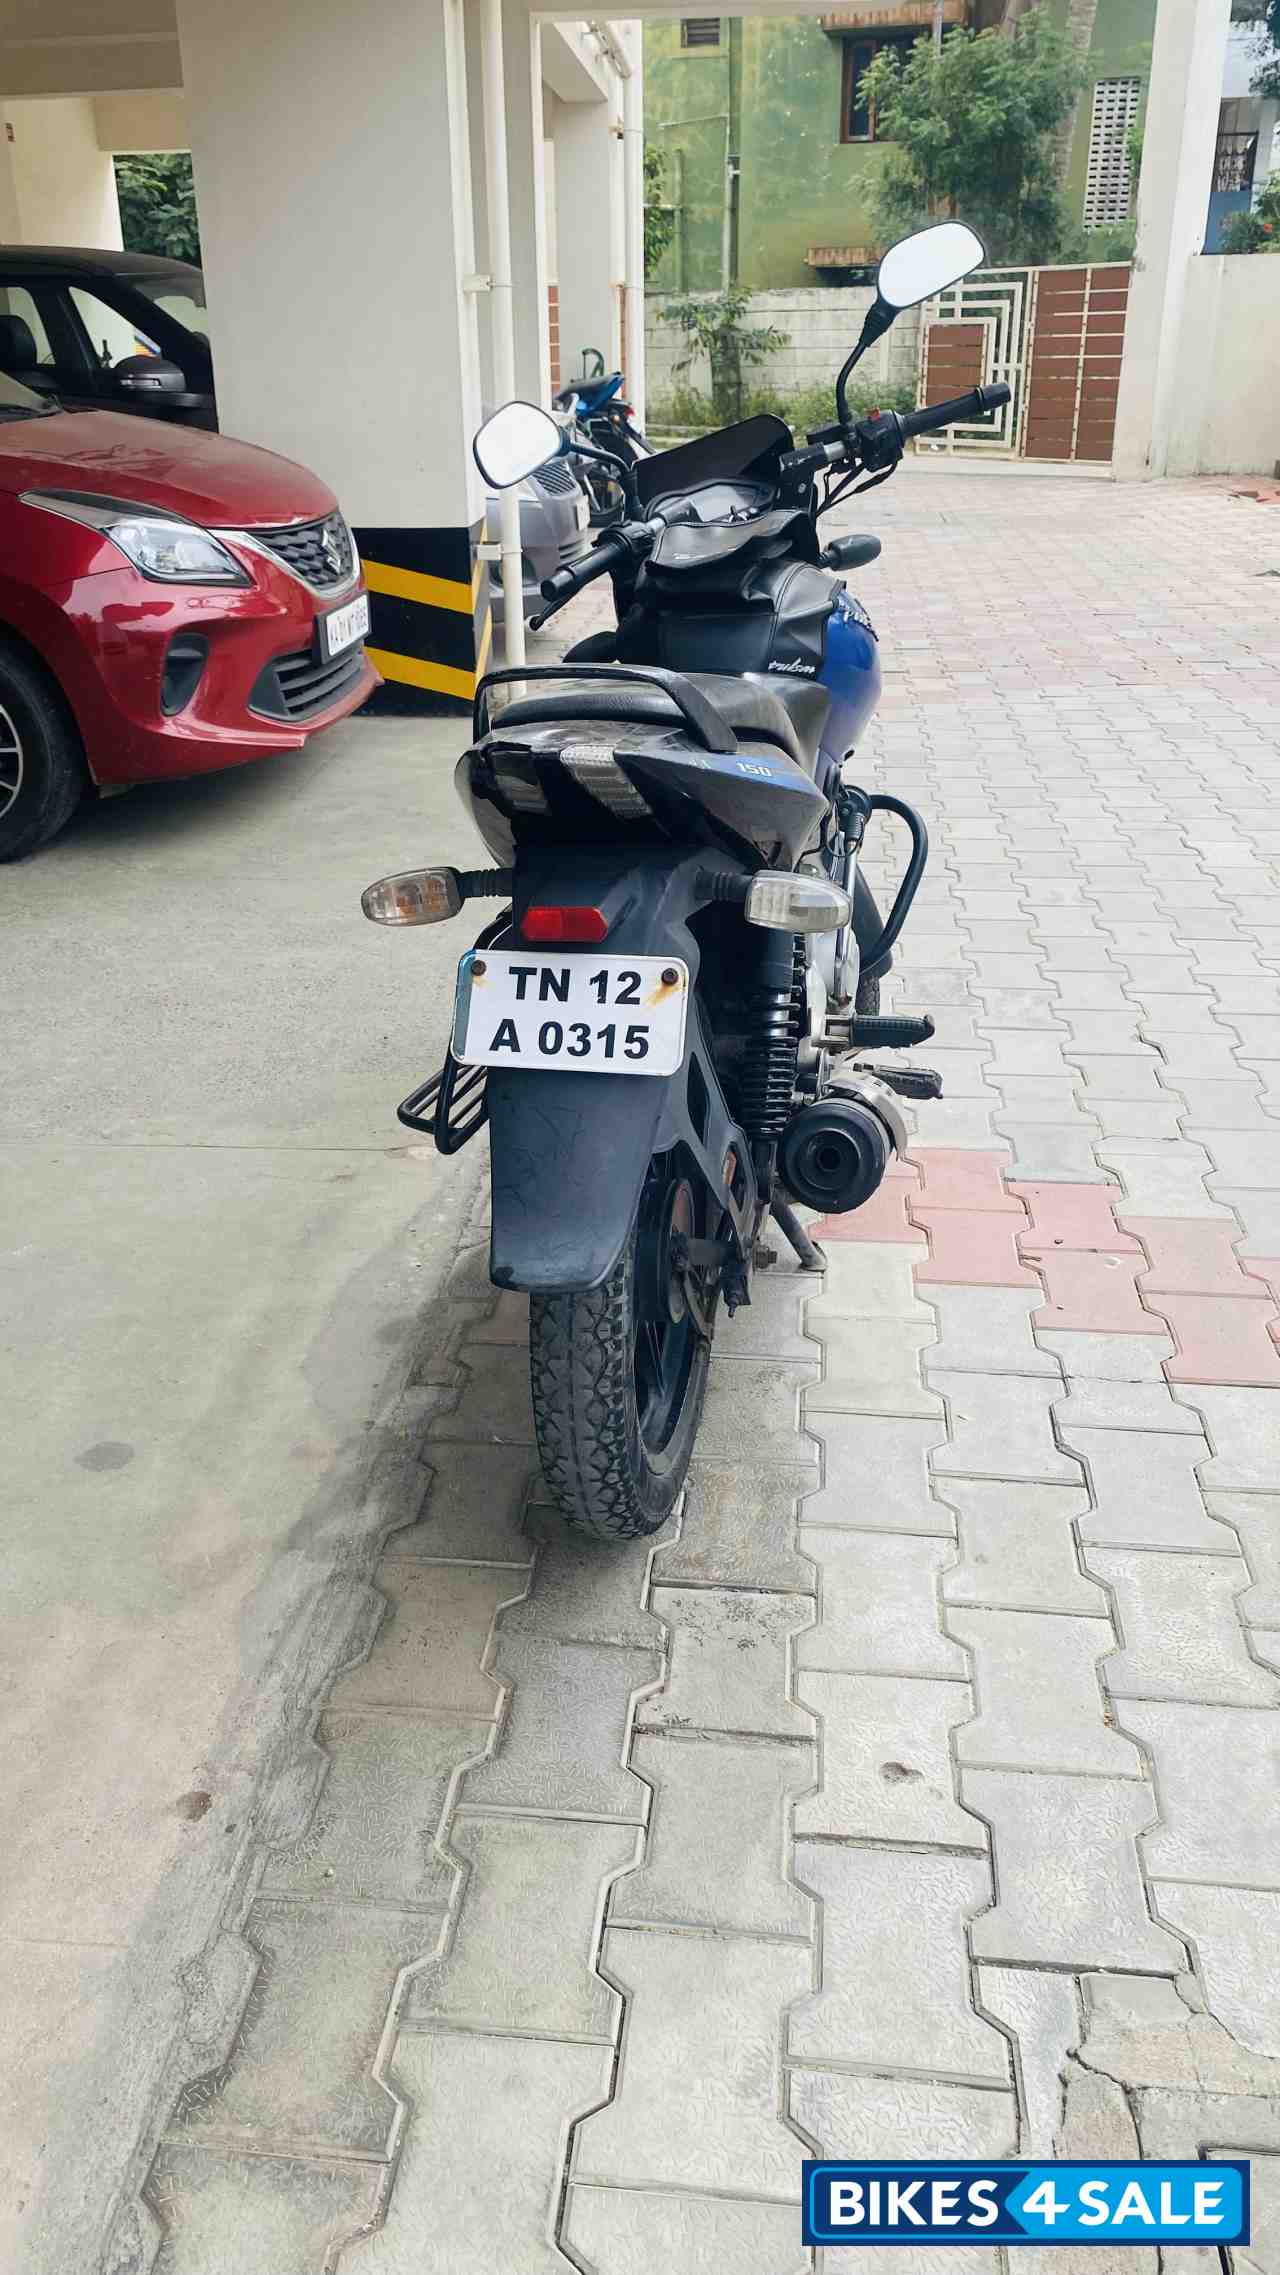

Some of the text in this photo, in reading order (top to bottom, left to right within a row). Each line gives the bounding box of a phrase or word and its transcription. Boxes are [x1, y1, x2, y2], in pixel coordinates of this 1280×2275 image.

[736, 762, 772, 777] 150
[508, 966, 642, 1006] TN 12
[488, 1018, 650, 1060] A 0315
